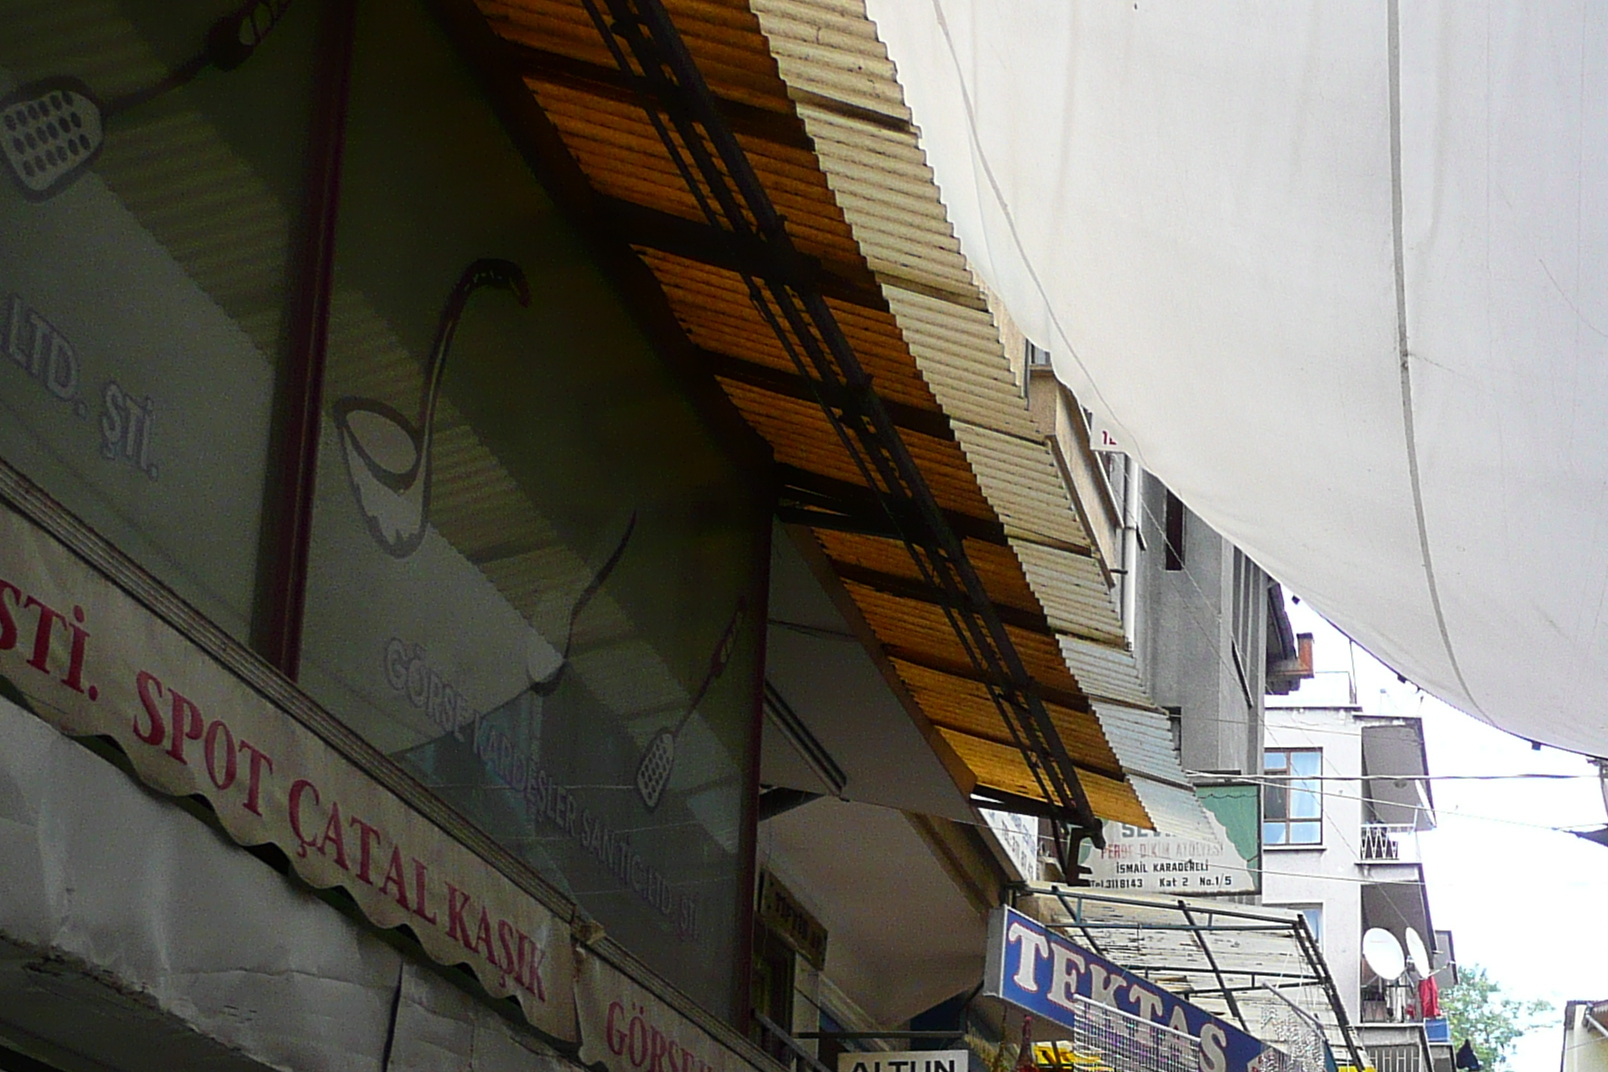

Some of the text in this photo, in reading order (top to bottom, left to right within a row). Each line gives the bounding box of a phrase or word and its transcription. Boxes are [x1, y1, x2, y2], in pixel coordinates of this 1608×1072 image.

[133, 670, 273, 817] SPOT
[288, 779, 437, 926] ÇATAL
[444, 880, 546, 1003] KAŞIK
[1116, 860, 1149, 874] İSMAİL
[1159, 878, 1178, 887] Kat
[1182, 877, 1189, 886] 2
